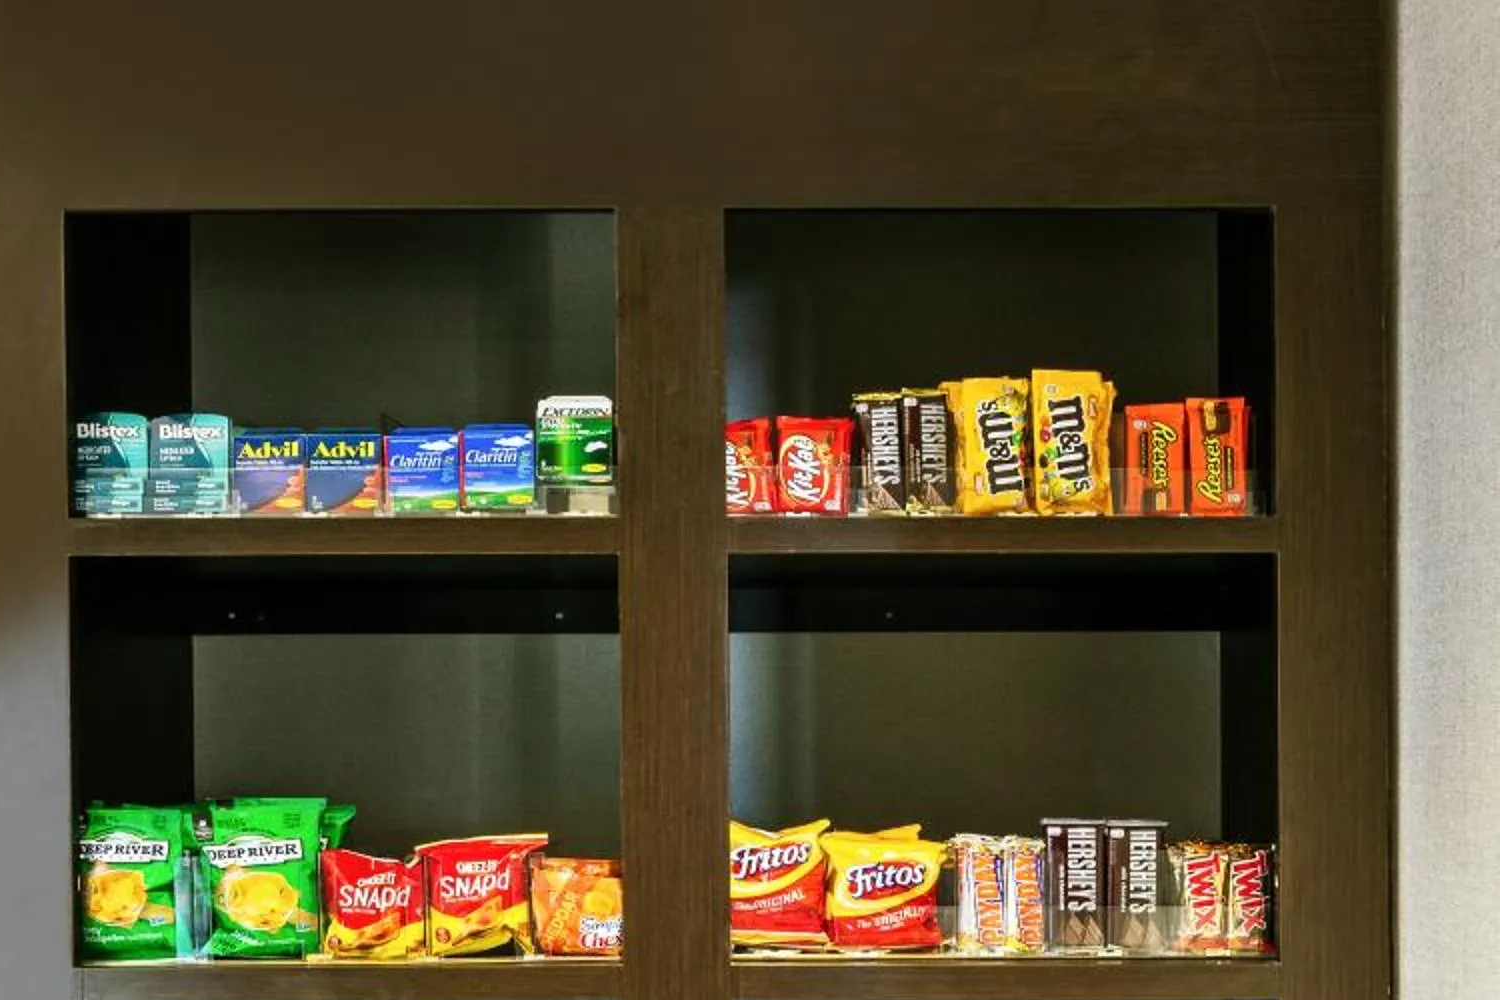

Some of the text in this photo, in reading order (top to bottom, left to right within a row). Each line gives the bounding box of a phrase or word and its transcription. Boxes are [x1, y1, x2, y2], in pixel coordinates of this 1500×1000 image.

[76, 423, 139, 439] Blistex
[160, 423, 221, 440] Blistex
[237, 441, 299, 458] Advil
[312, 441, 375, 458] Advil
[465, 449, 517, 463] Claritin
[390, 454, 442, 468] Claritin
[1197, 436, 1222, 503] Reese's
[114, 844, 164, 856] RIVER
[209, 843, 298, 861] DEEP RIVER
[731, 842, 812, 881] Fritos
[847, 862, 927, 898] Fritos
